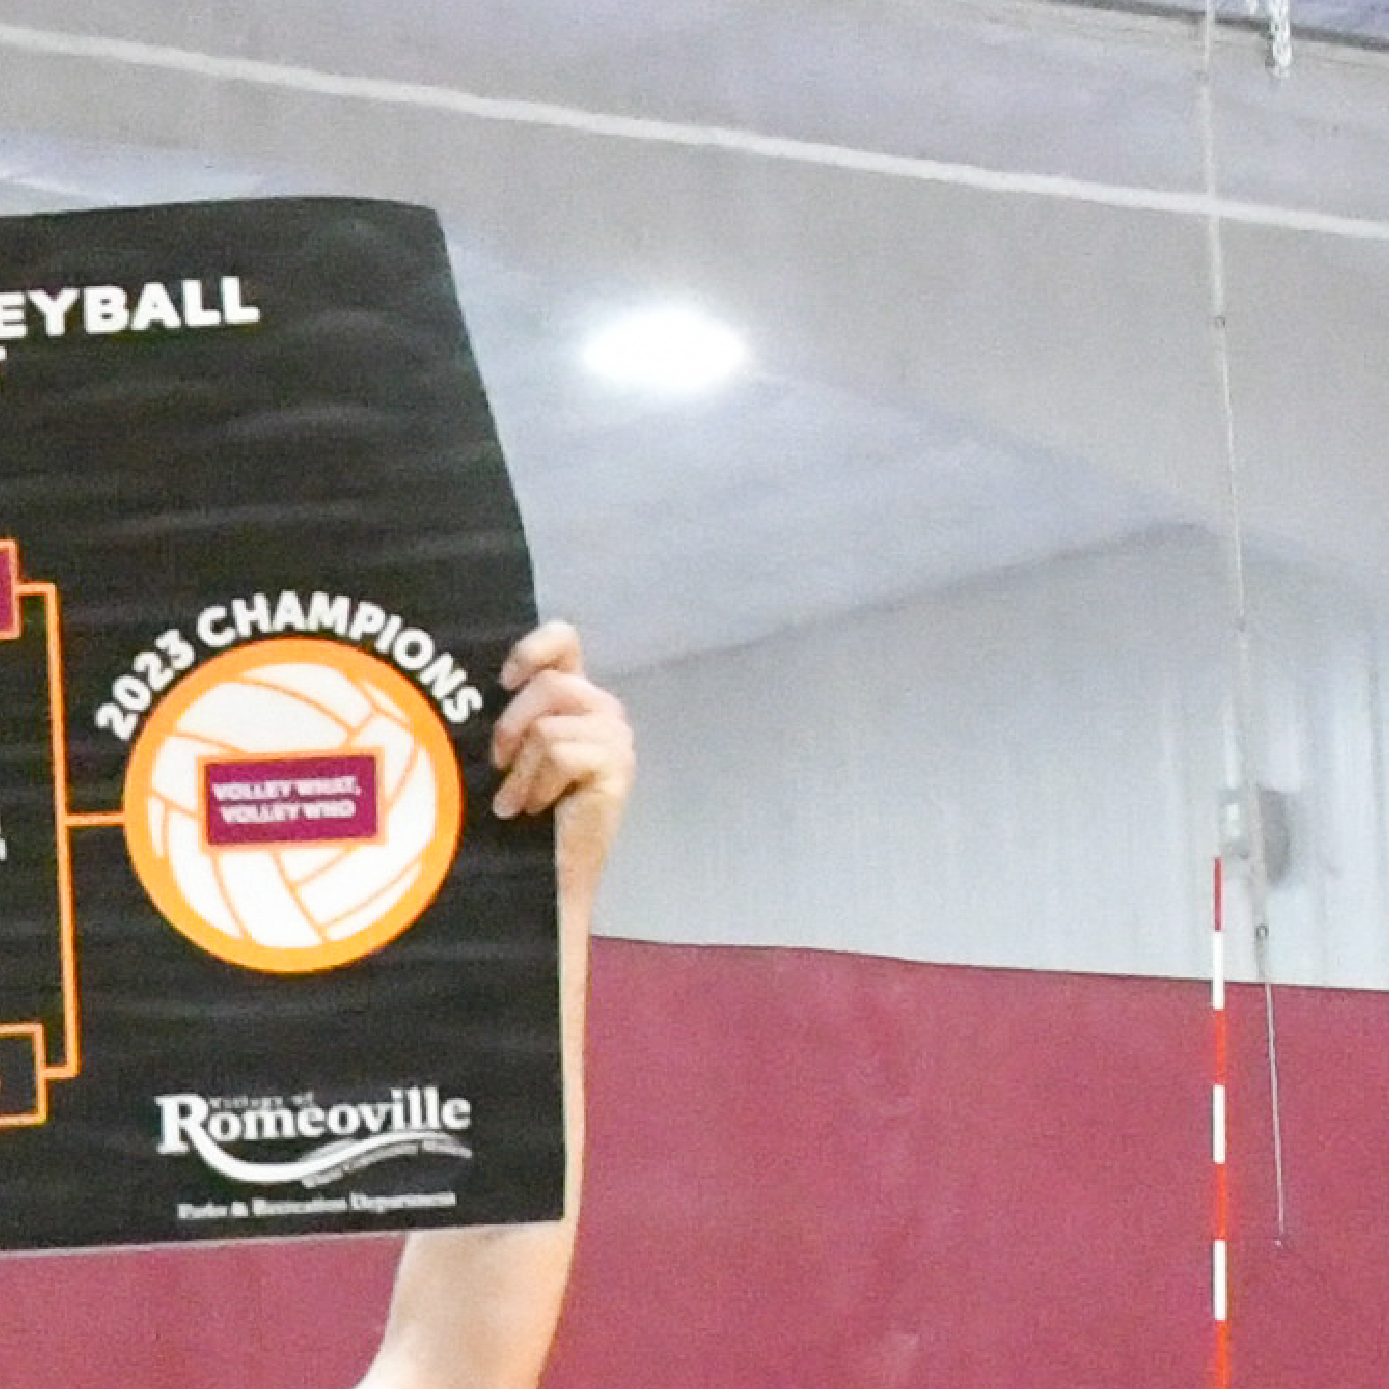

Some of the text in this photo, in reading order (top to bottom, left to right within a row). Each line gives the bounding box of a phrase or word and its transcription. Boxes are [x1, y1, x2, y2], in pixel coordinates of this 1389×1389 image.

[95, 590, 484, 740] 2023 CHAMPIONS
[155, 1085, 472, 1155] Romeoville
